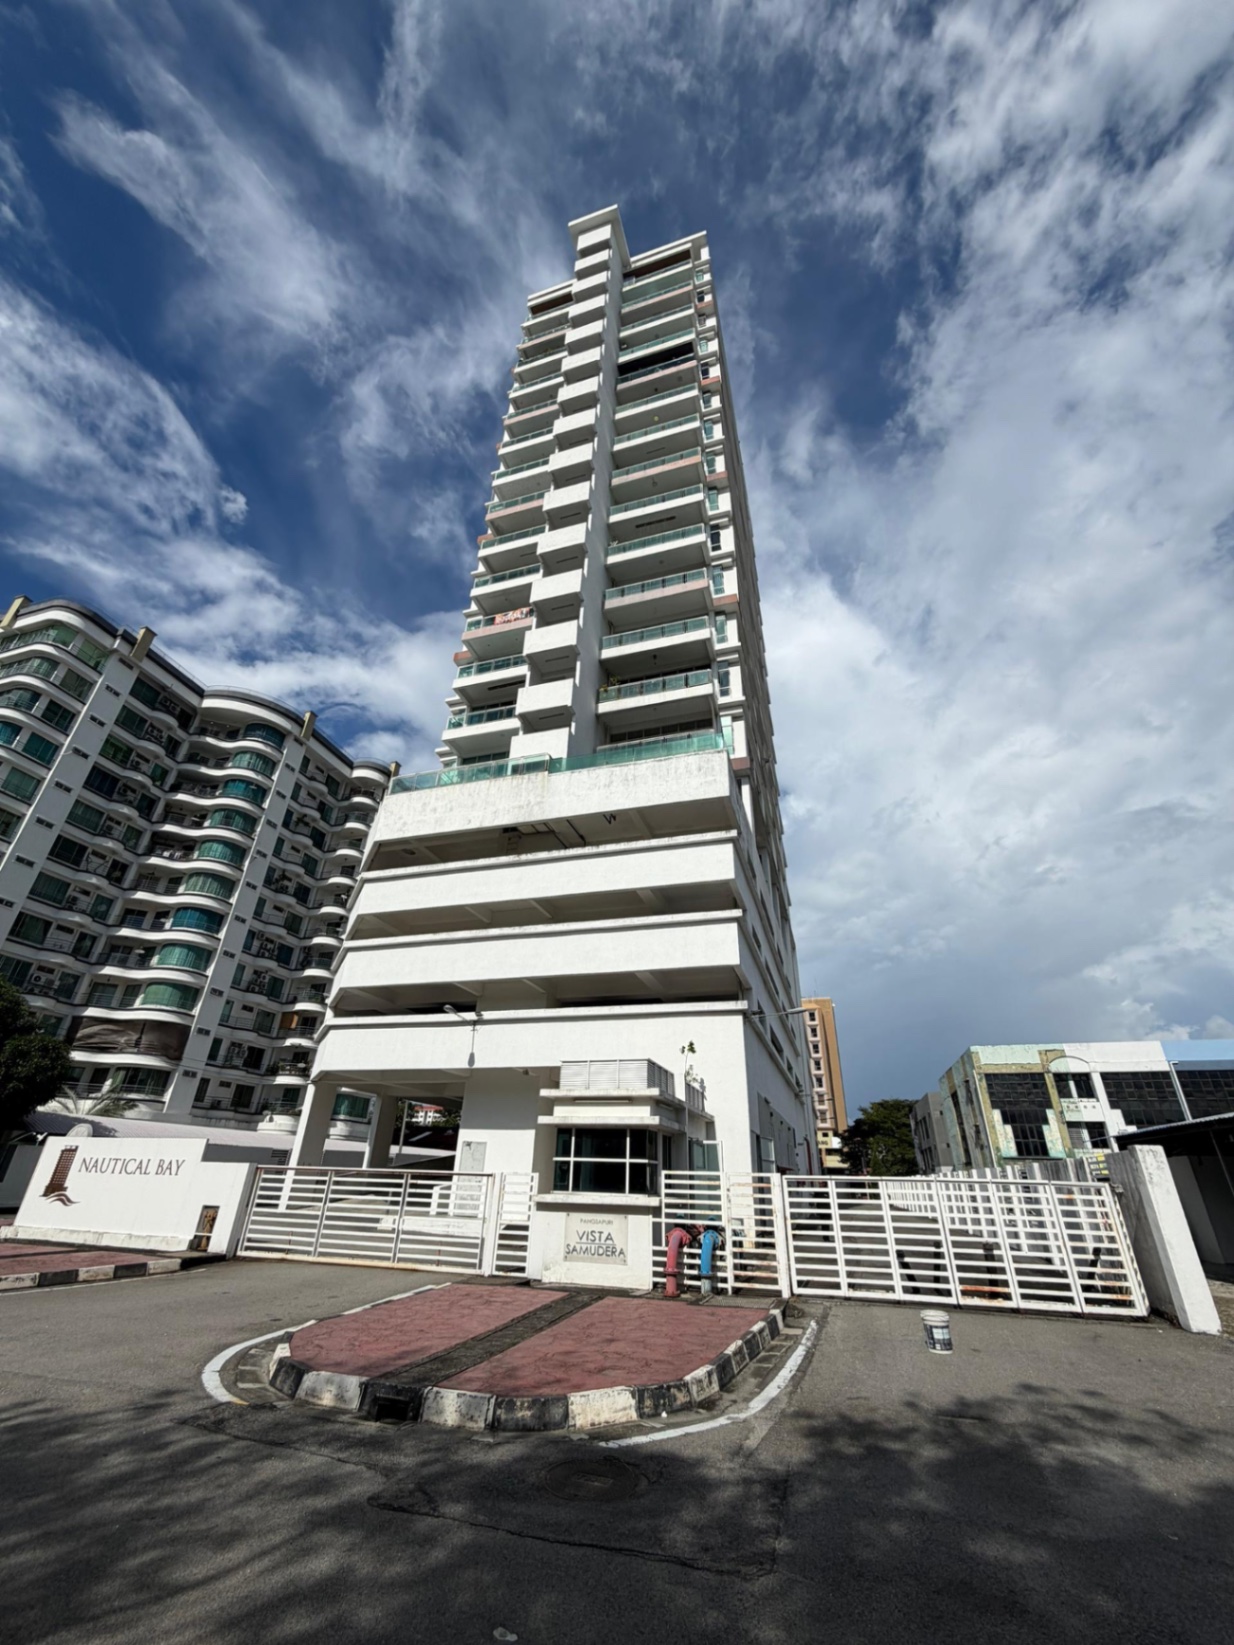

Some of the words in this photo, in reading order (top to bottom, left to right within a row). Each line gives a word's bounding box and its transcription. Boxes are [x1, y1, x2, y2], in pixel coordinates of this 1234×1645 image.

[78, 1157, 151, 1175] NAUTICAL
[155, 1158, 185, 1175] BAY
[576, 1230, 615, 1243] VISTA
[566, 1243, 626, 1258] SAMUDERA
